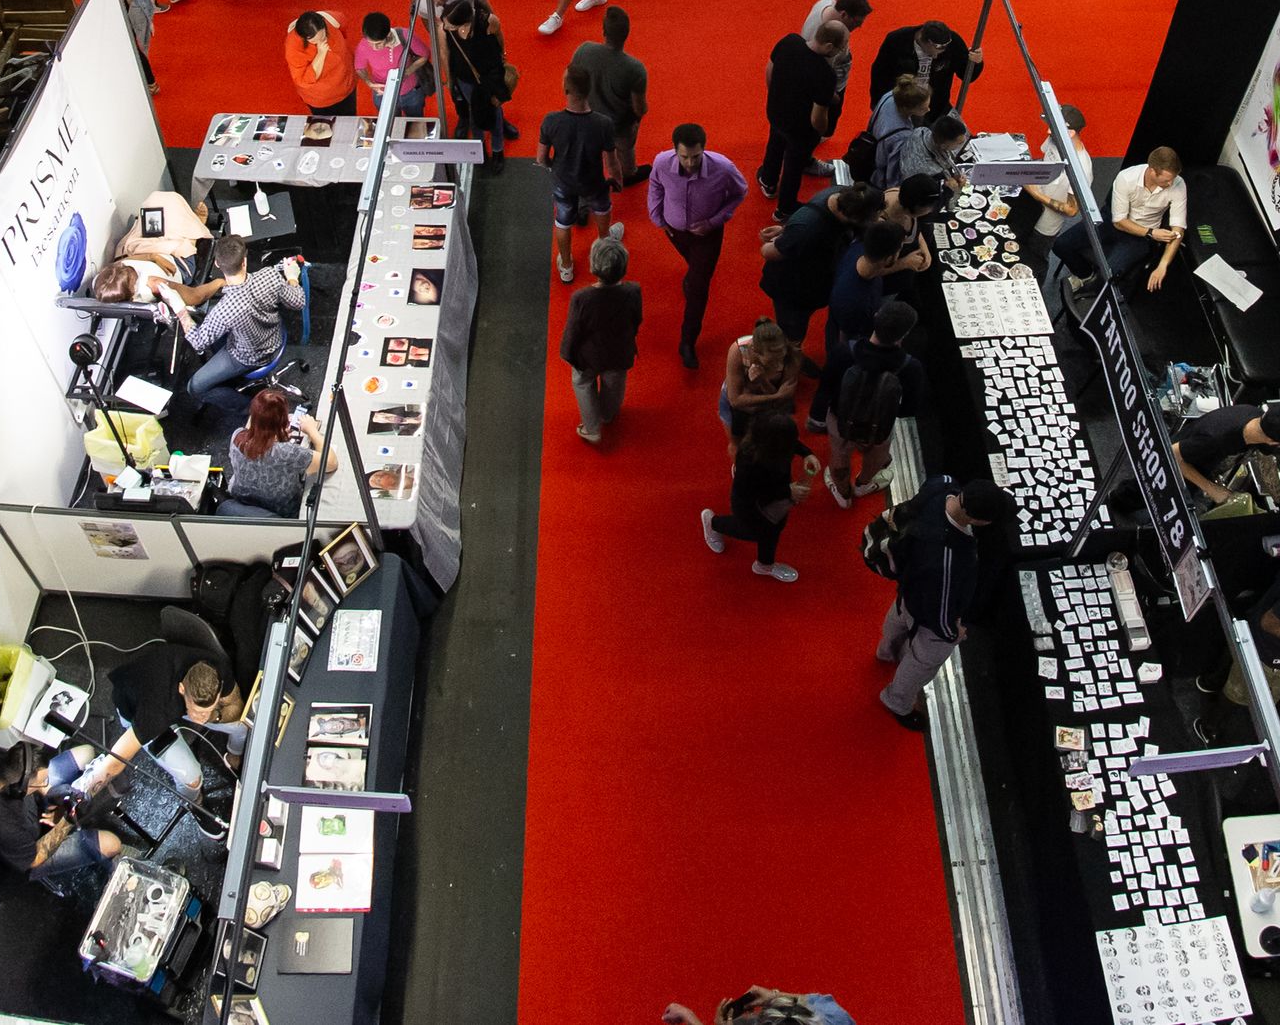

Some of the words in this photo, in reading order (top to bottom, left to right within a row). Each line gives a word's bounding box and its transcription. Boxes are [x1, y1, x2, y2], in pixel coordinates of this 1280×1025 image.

[0, 103, 77, 267] PRISME
[30, 166, 81, 269] Besançon
[1099, 299, 1137, 411] TATTOO
[1131, 409, 1167, 493] SHOP
[1163, 496, 1186, 550] 78
